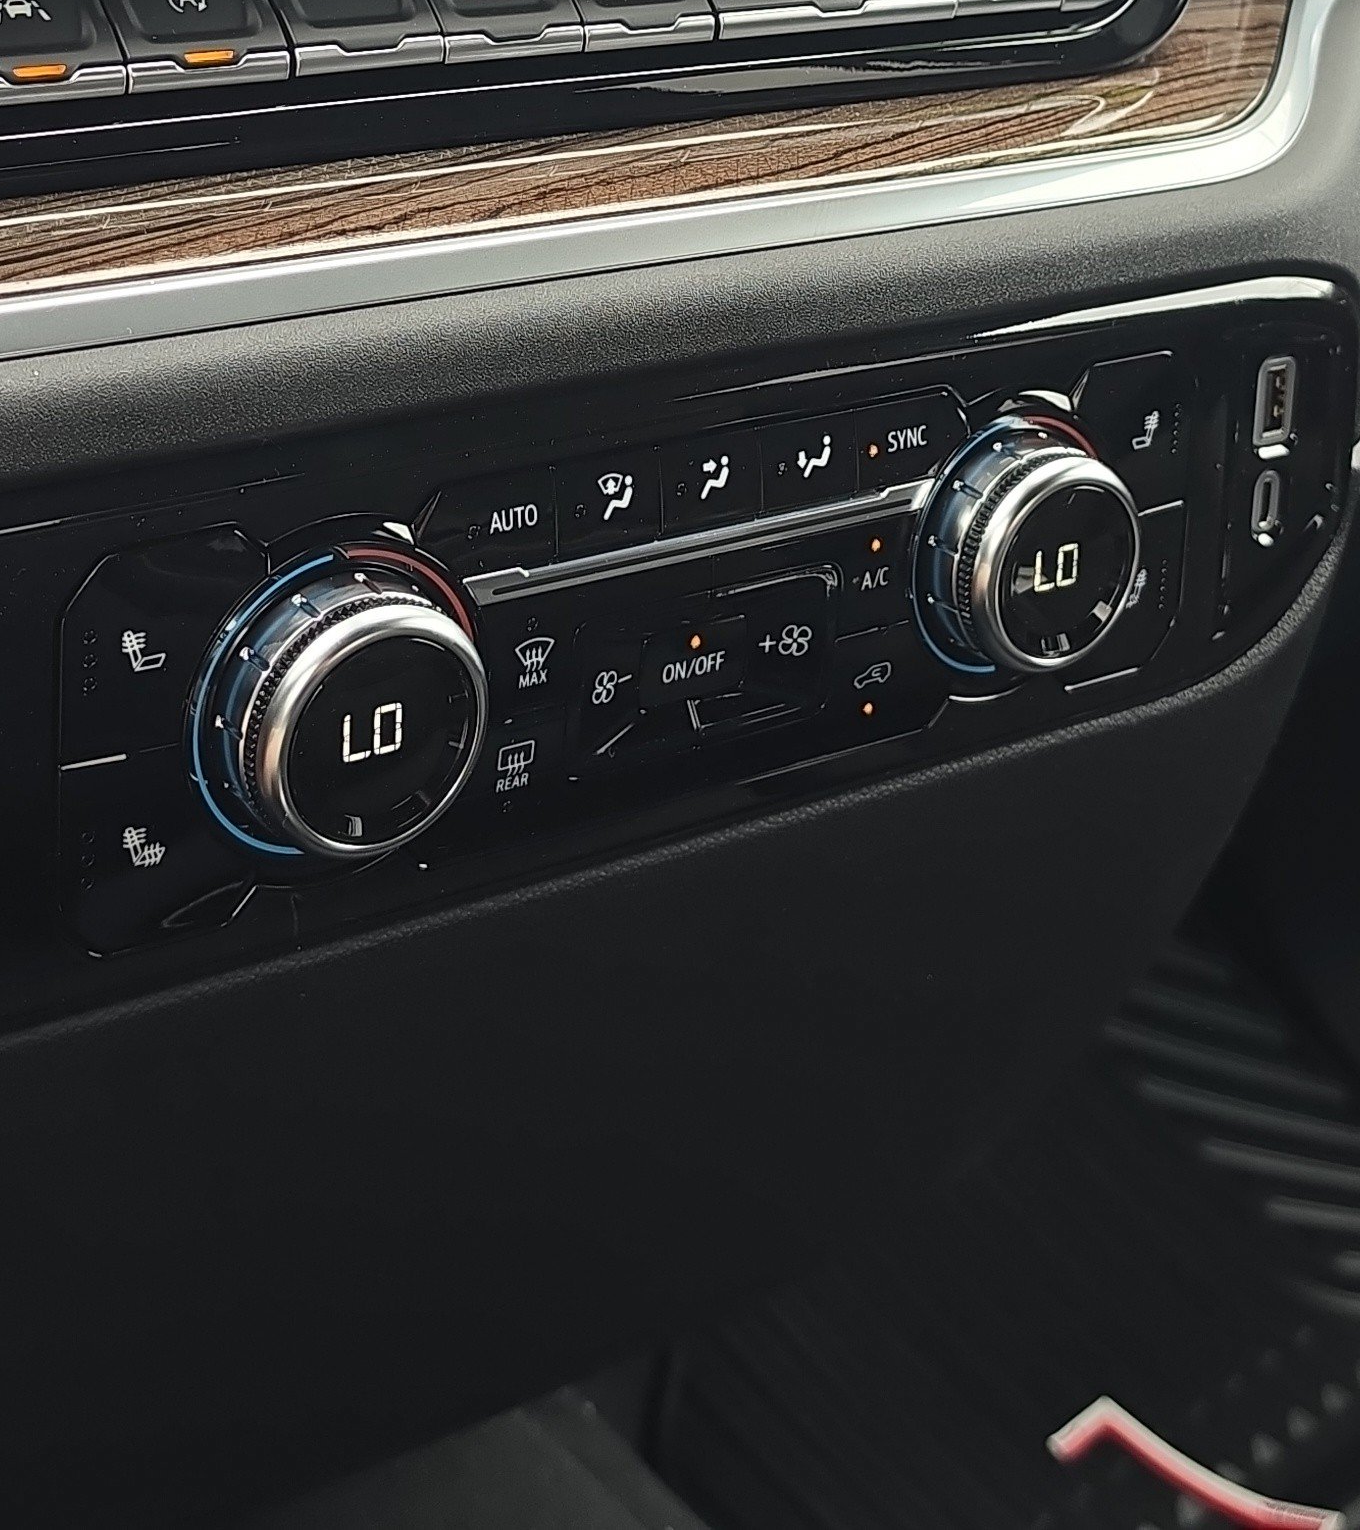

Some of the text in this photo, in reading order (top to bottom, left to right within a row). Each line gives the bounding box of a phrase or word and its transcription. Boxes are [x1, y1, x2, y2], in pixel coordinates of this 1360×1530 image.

[887, 425, 928, 452] SYNC
[490, 503, 538, 535] AUTO
[860, 566, 890, 592] A/C
[518, 668, 548, 689] MAX
[661, 650, 726, 684] ON/OFF
[495, 773, 530, 793] REAR
